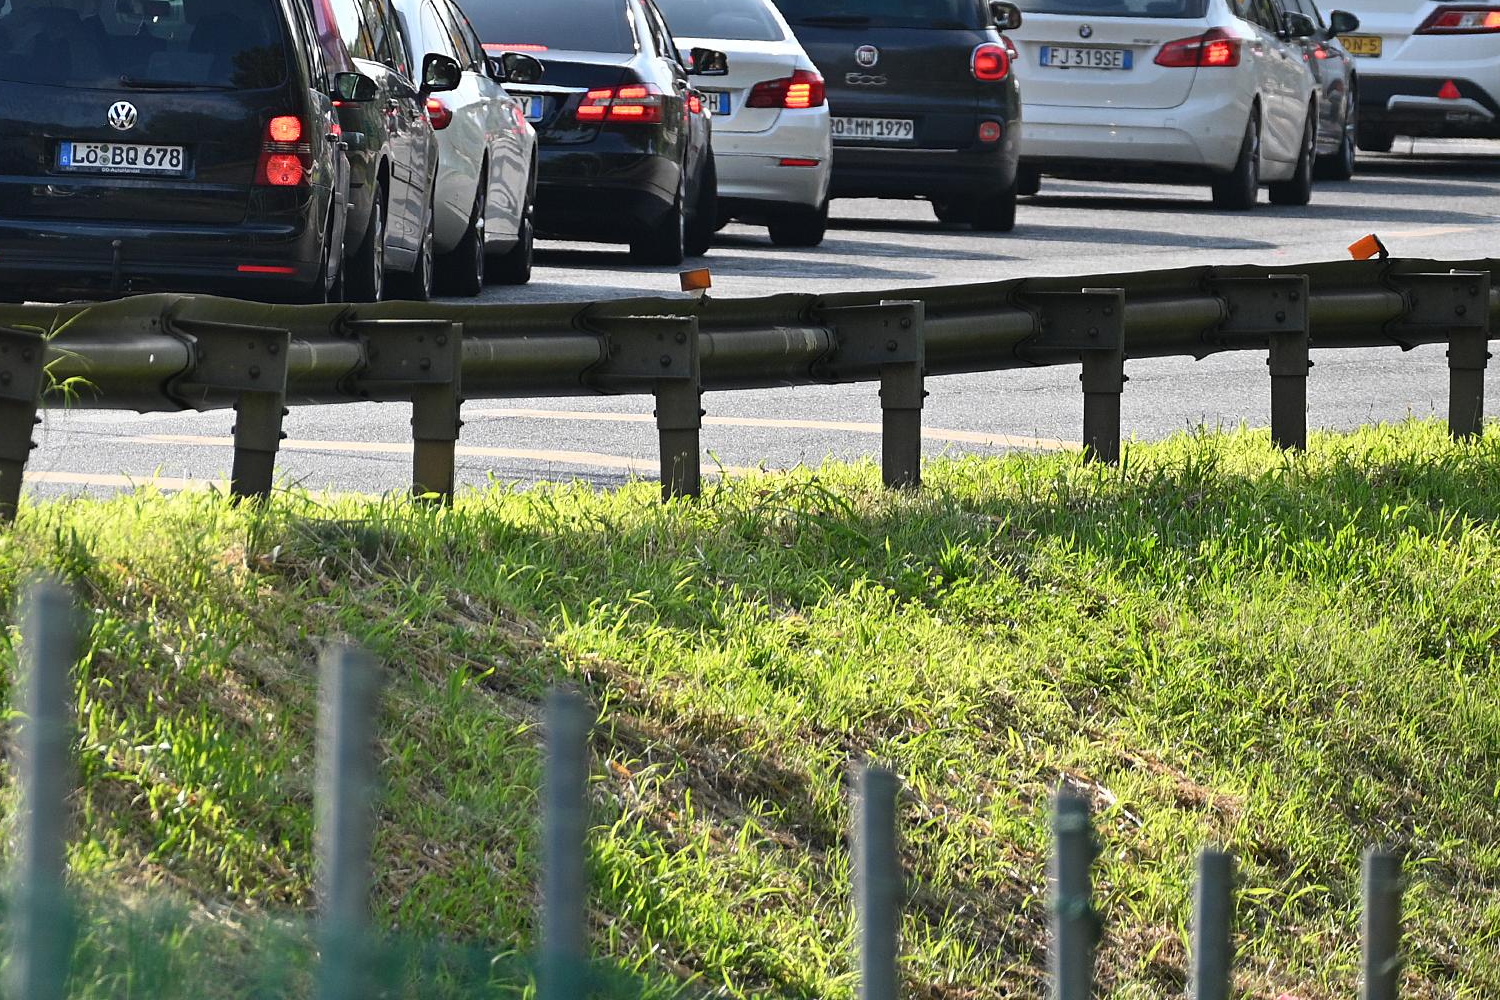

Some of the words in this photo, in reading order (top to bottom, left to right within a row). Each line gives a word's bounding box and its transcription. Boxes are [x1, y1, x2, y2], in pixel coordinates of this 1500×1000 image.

[1075, 49, 1122, 66] 319SE
[855, 121, 873, 135] MM
[877, 121, 912, 136] 1979
[72, 145, 99, 164] LÖ
[111, 147, 139, 166] BQ
[143, 148, 181, 168] 678
